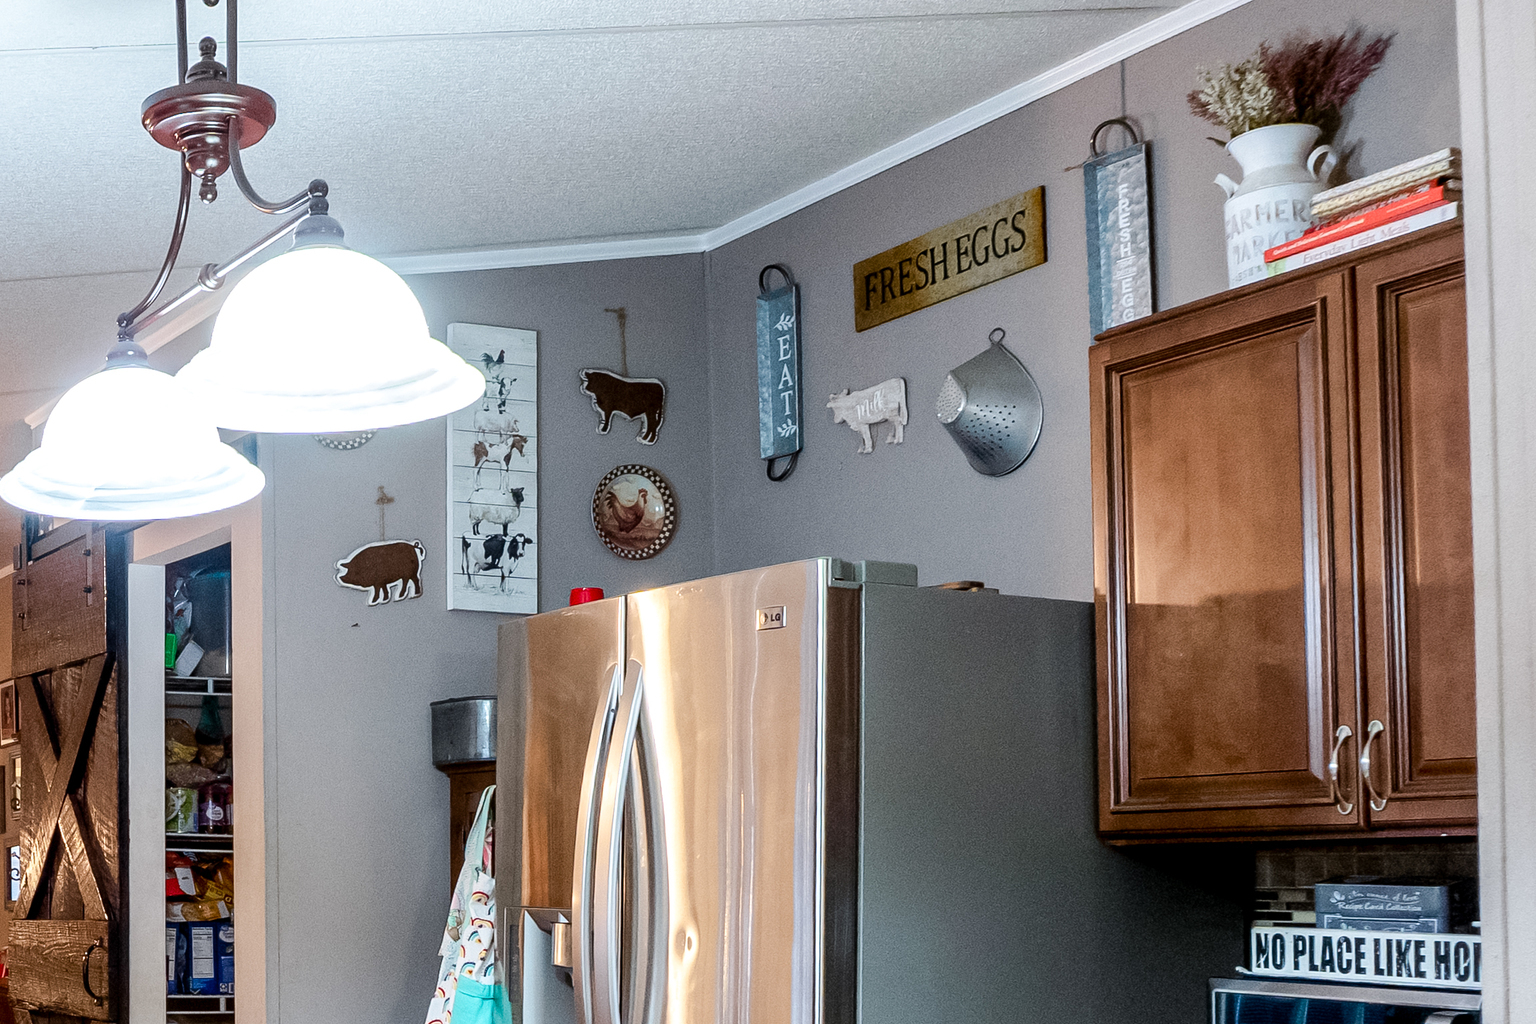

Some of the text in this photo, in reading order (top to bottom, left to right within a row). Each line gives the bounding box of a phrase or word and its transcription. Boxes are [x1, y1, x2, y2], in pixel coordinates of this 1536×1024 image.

[1118, 183, 1132, 258] FRESH
[864, 209, 1027, 311] FRESH EGGS
[1121, 278, 1135, 322] EGG
[776, 335, 794, 416] EAT
[770, 613, 781, 622] LG
[1255, 933, 1481, 983] NO PLACE LIKE HO
